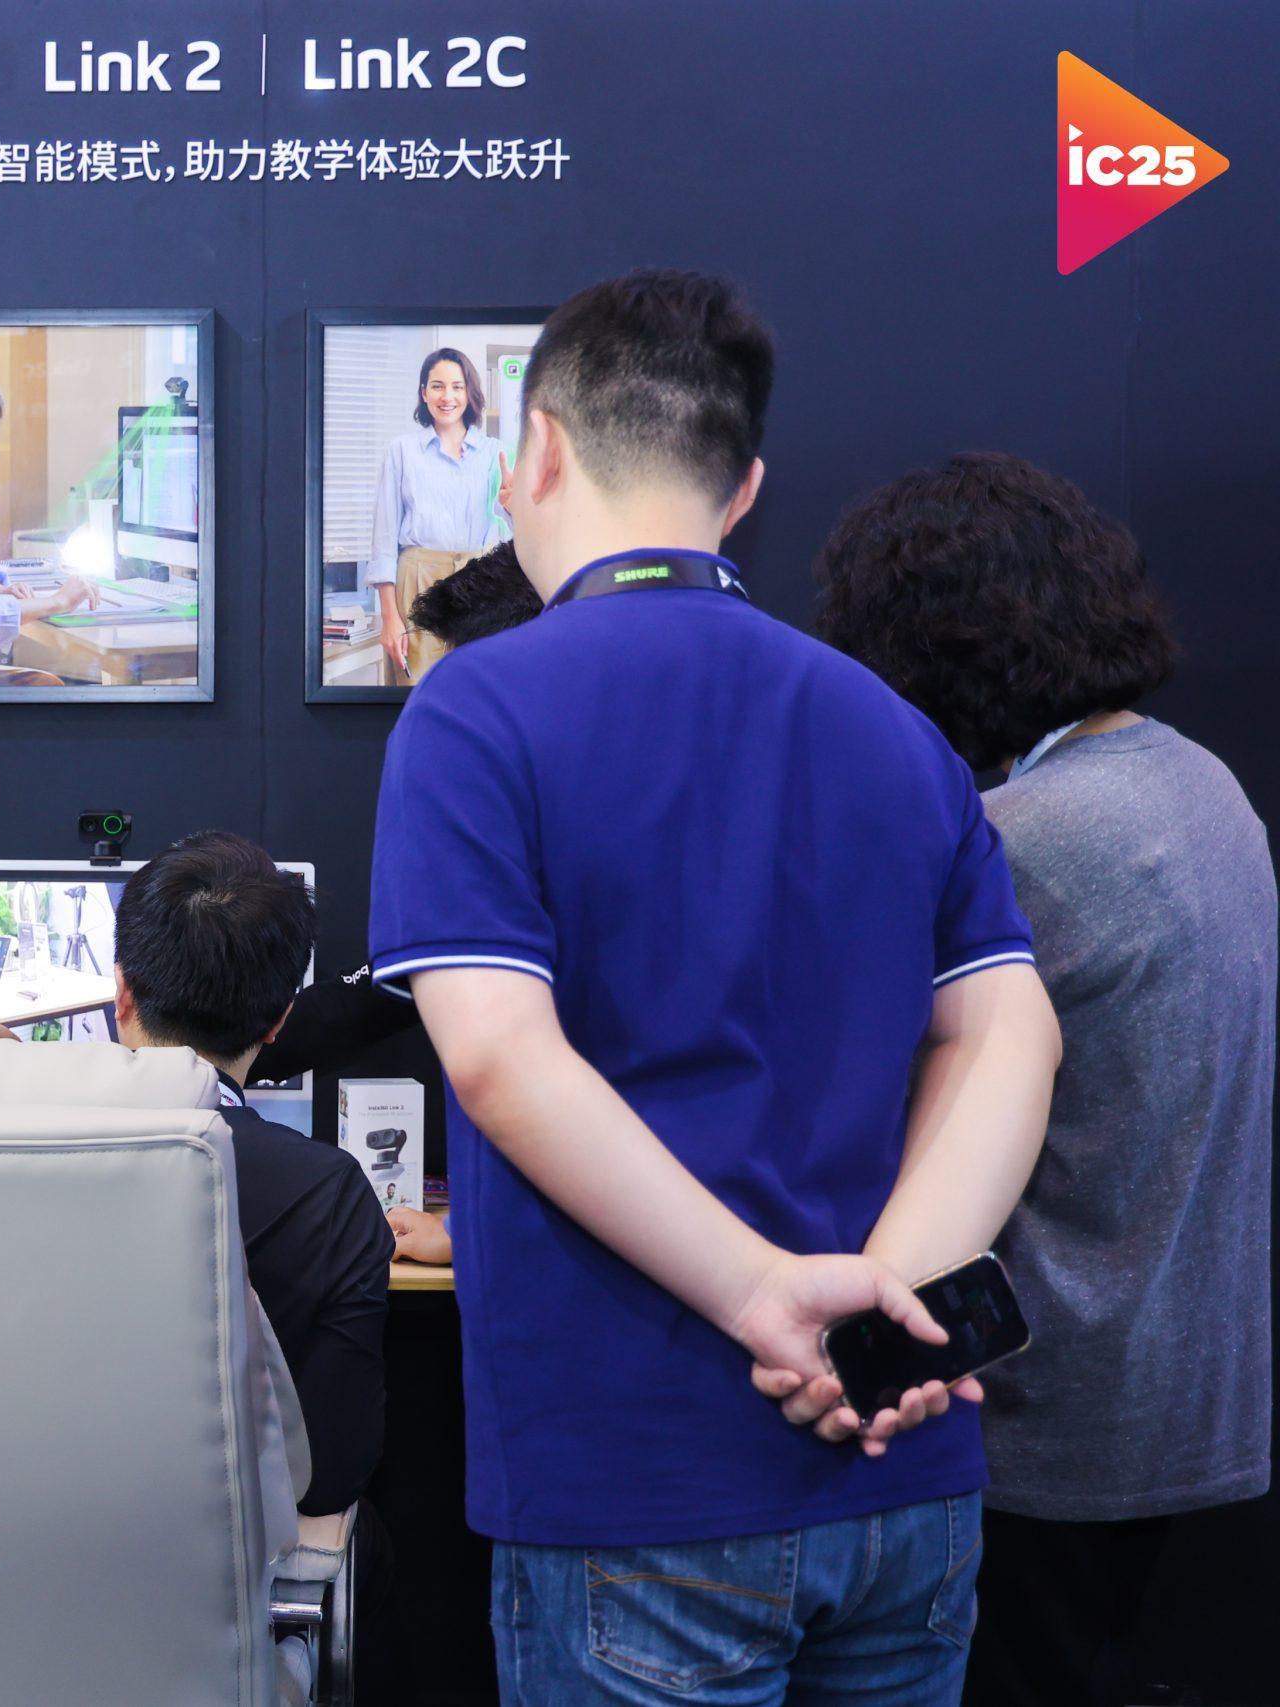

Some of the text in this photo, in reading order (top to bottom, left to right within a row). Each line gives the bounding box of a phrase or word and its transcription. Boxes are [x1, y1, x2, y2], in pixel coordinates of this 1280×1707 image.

[45, 36, 526, 91] Link 2 Link 2C
[614, 566, 669, 583] SHURE
